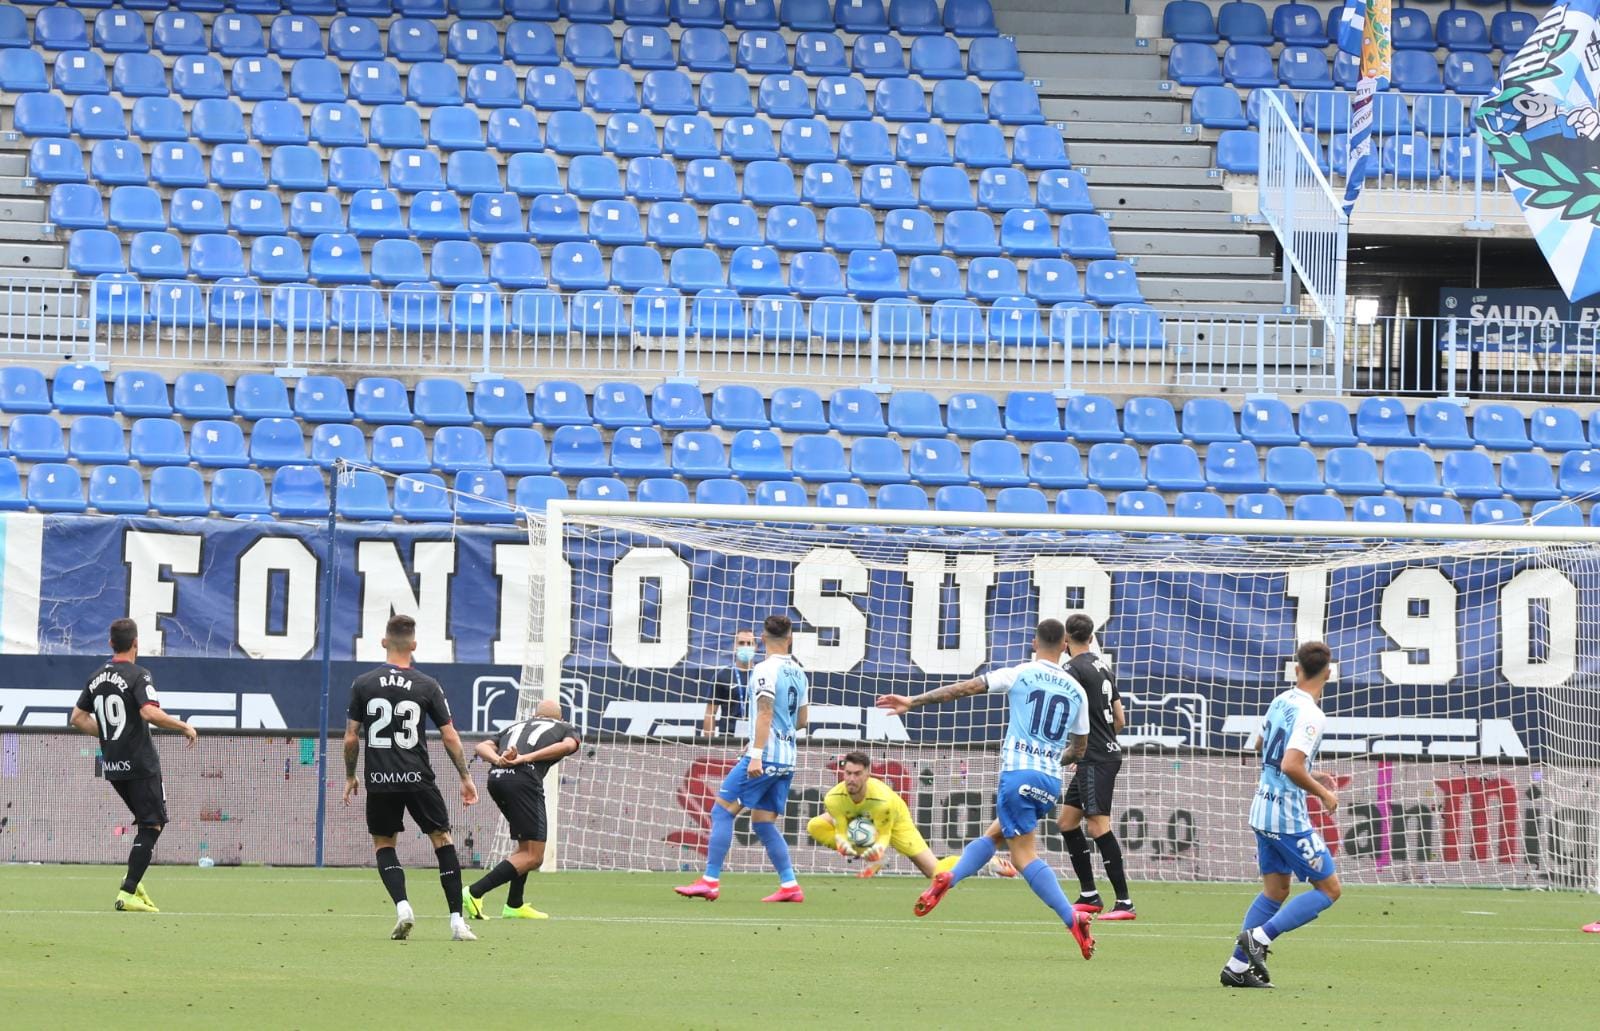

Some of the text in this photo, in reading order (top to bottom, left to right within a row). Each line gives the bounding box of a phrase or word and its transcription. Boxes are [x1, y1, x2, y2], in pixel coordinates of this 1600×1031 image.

[1470, 304, 1561, 328] SALIDA
[123, 529, 1577, 687] FONDO SUR 190
[379, 675, 412, 691] RABA
[787, 686, 798, 717] 9
[1026, 689, 1071, 741] 10
[1102, 679, 1114, 724] 3
[93, 694, 127, 741] 19
[366, 697, 422, 750] 23
[506, 720, 557, 748] 17
[370, 771, 422, 784] SOMMOS
[1297, 832, 1325, 861] 34
